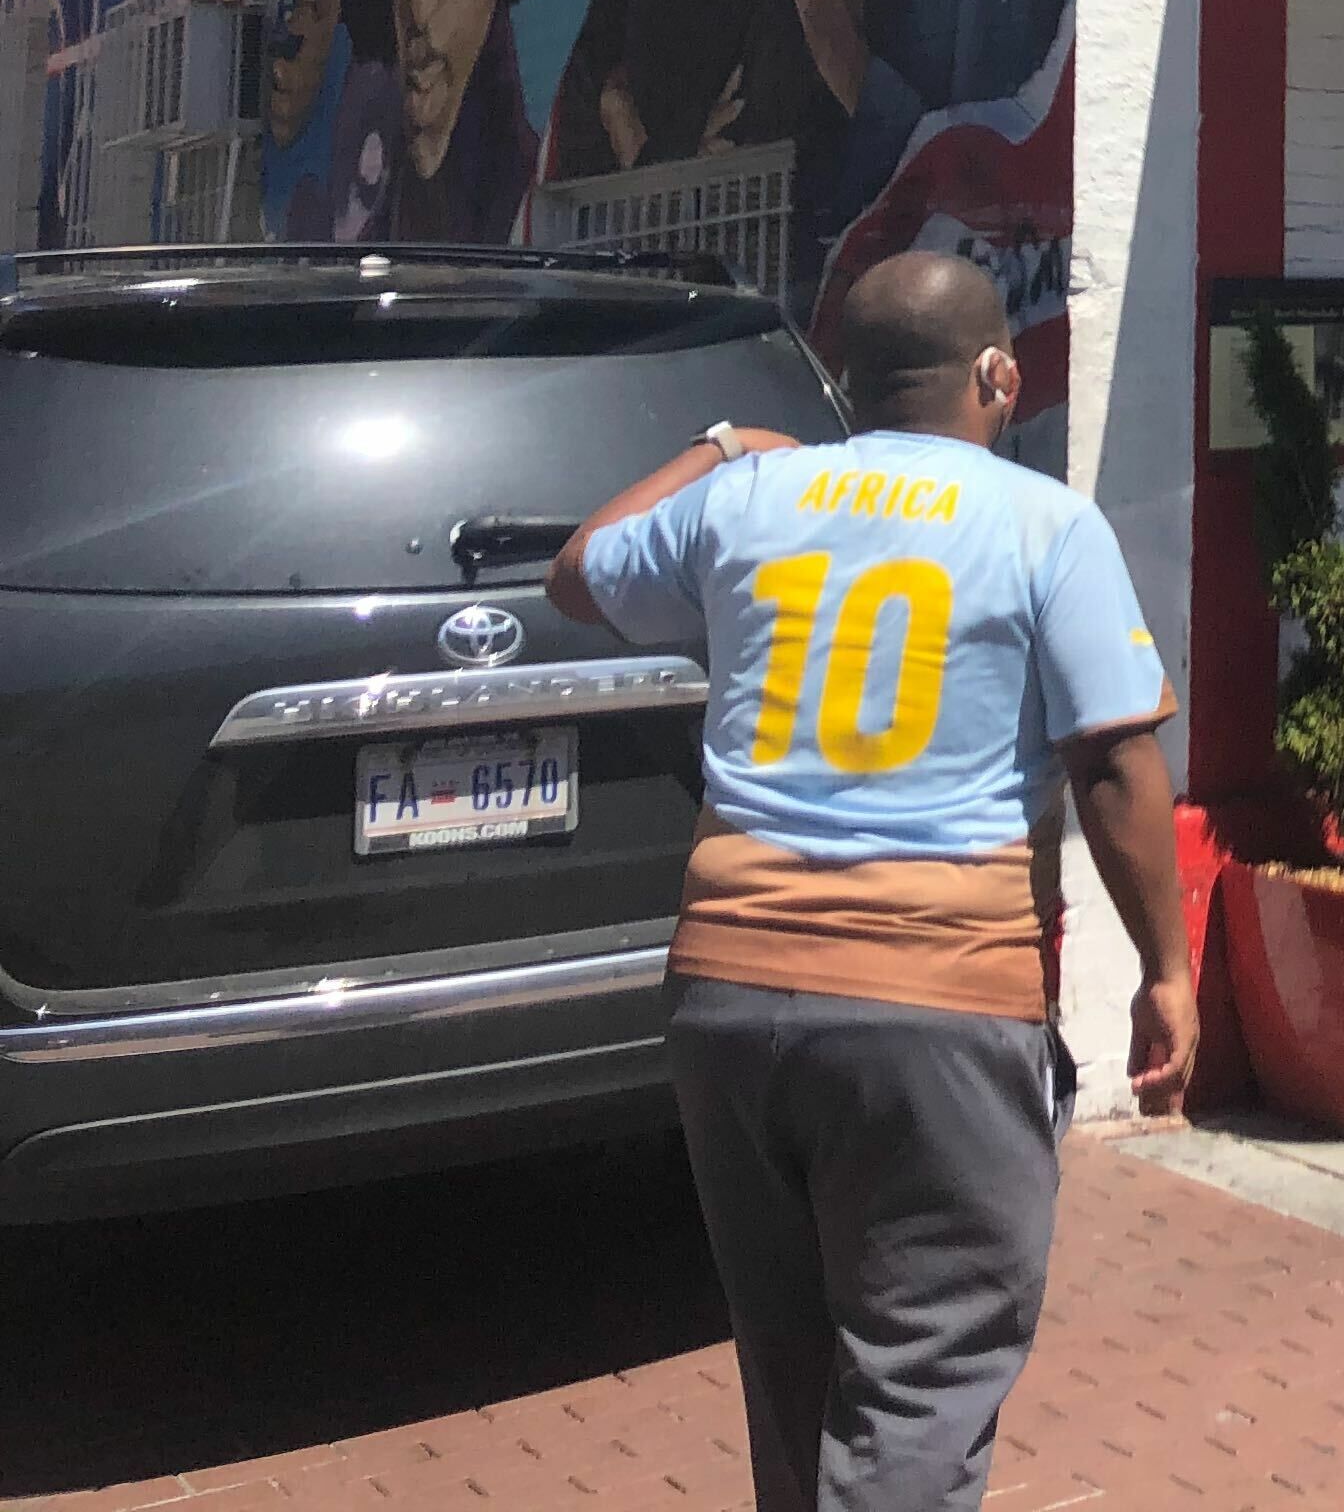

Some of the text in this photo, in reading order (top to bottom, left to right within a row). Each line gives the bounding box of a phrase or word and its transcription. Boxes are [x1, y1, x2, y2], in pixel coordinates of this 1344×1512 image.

[797, 469, 963, 525] AFRICA
[750, 550, 956, 775] 10
[369, 757, 558, 823] FA 6570
